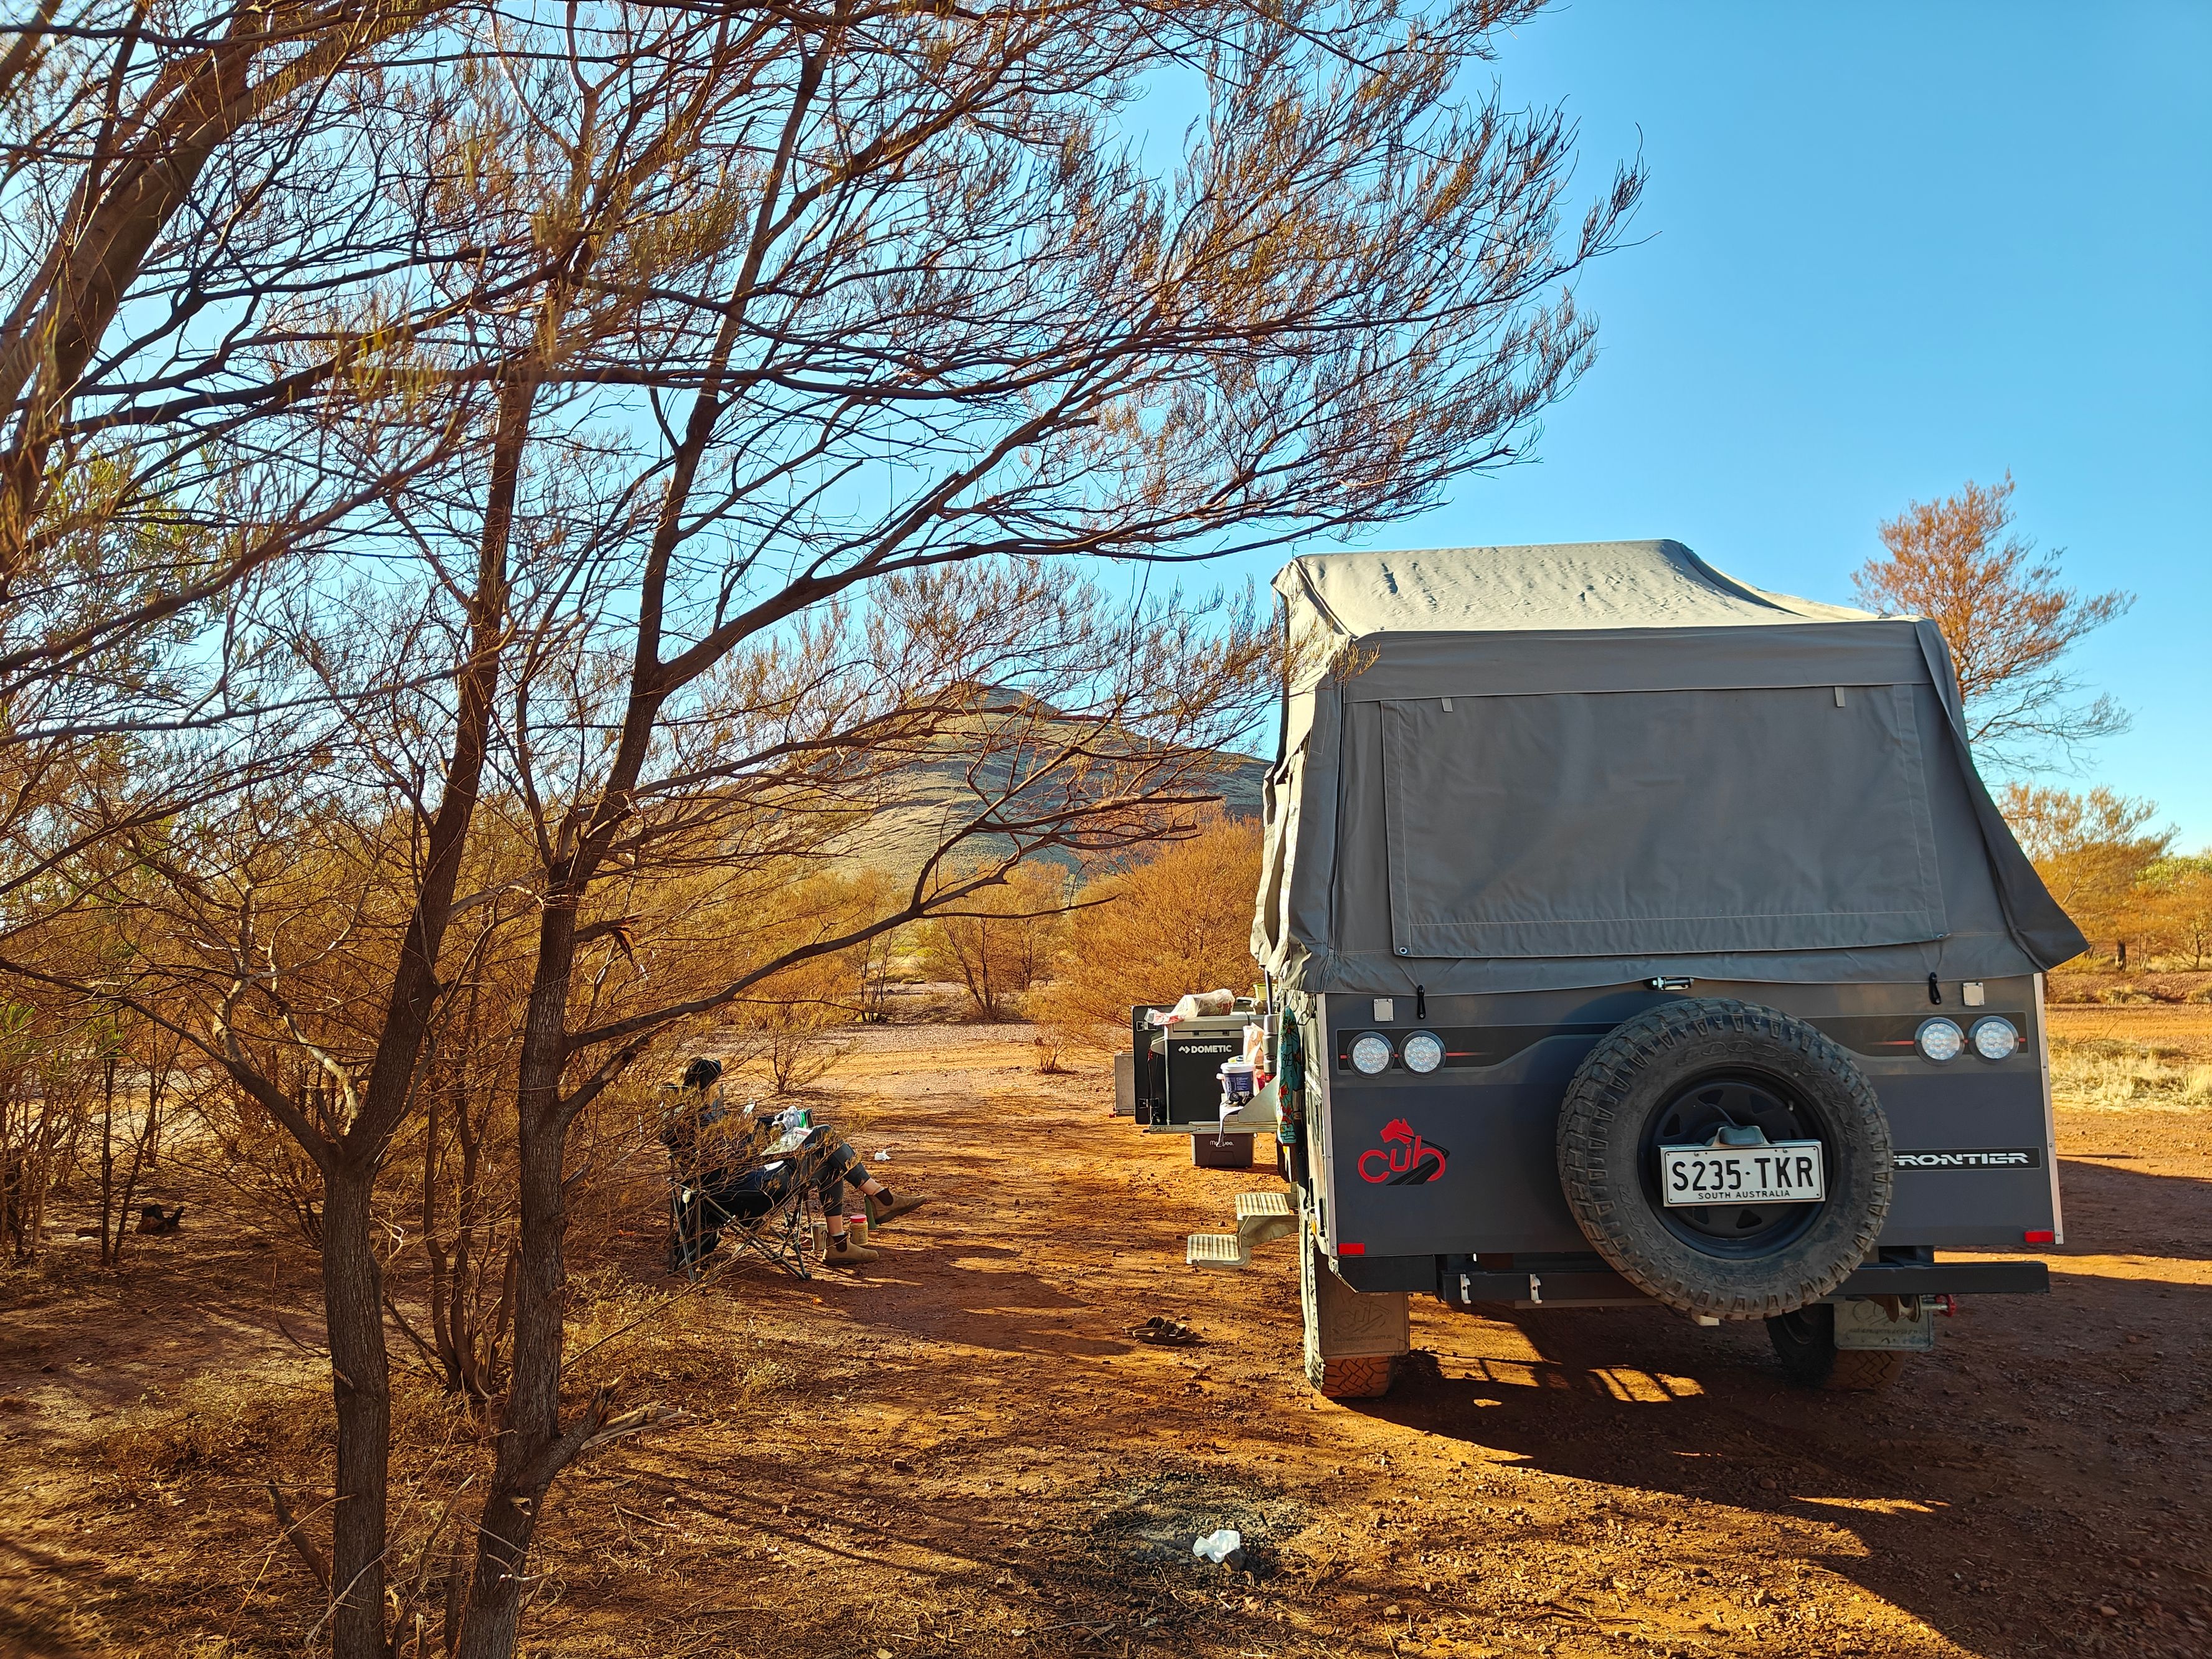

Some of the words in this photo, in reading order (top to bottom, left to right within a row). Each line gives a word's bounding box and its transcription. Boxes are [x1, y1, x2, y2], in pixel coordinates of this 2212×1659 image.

[1191, 1045, 1232, 1053] DOMETIC
[1893, 1153, 2030, 1166] RONTIER
[1736, 1190, 1790, 1198] AUSTRALIA
